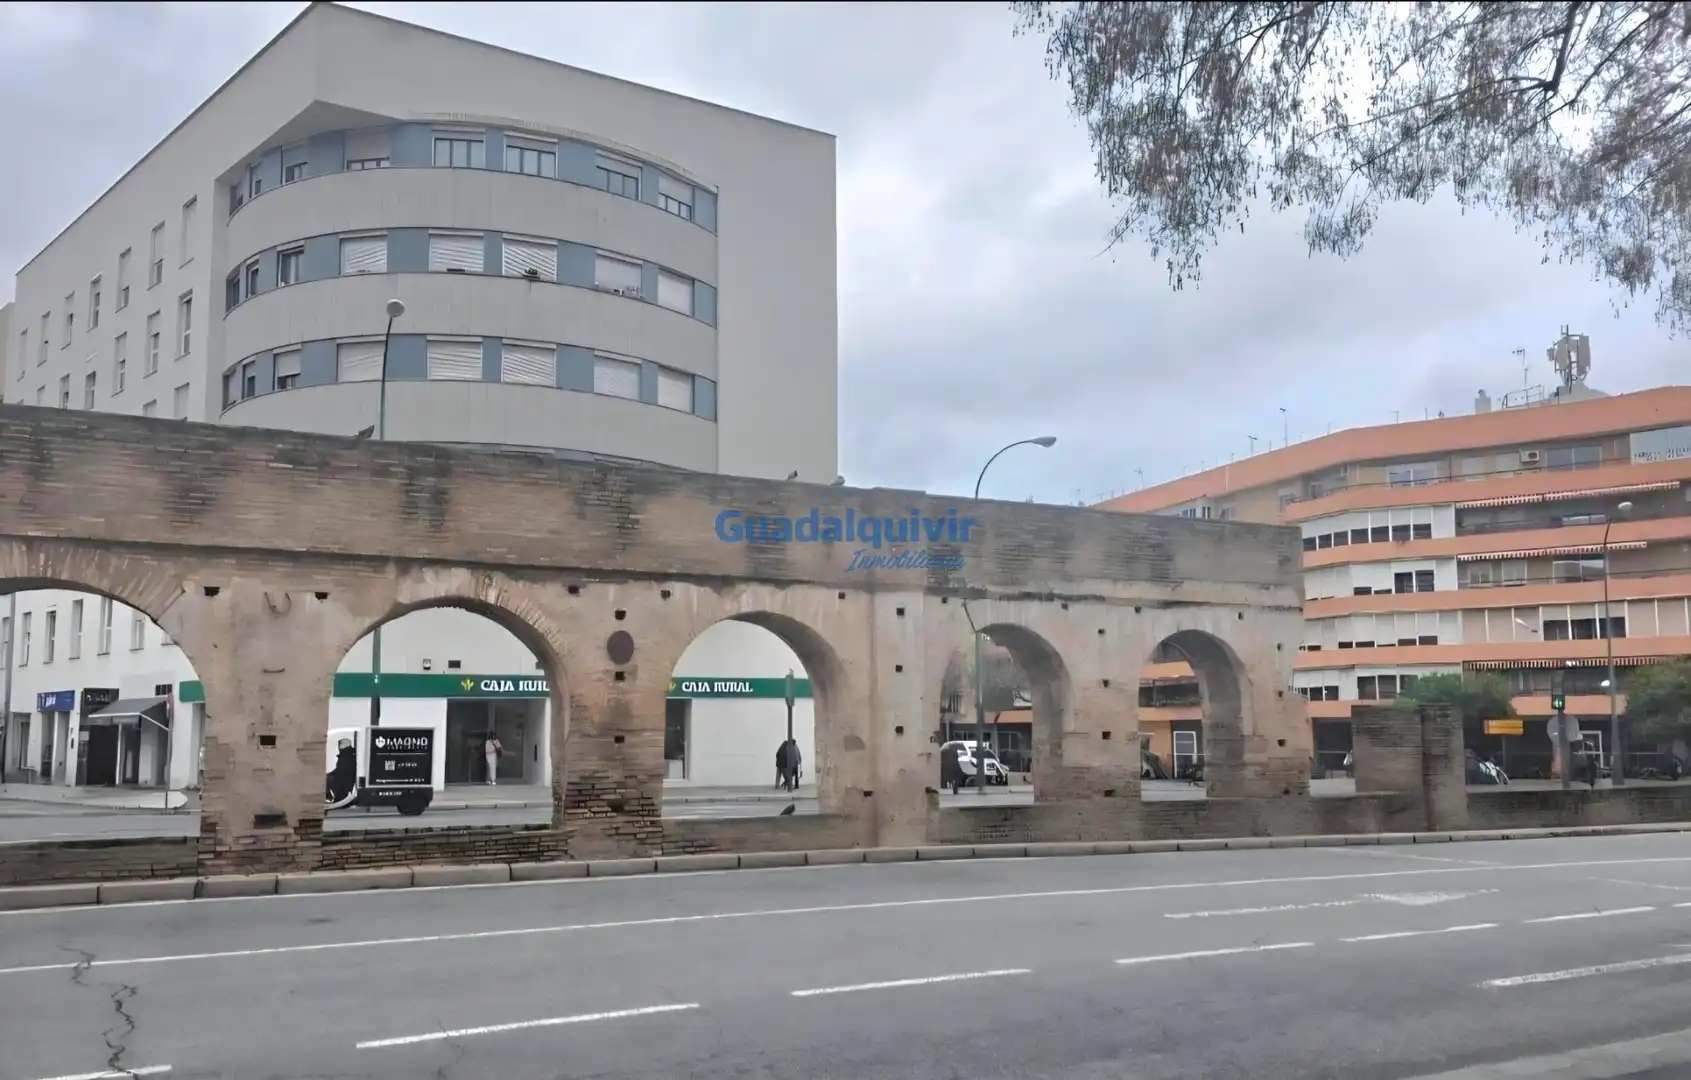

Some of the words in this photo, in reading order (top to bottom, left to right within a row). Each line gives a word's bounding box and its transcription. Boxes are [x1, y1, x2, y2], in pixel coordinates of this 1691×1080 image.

[480, 679, 515, 693] CAJA
[681, 681, 711, 693] CAJA
[713, 681, 754, 693] RURAL
